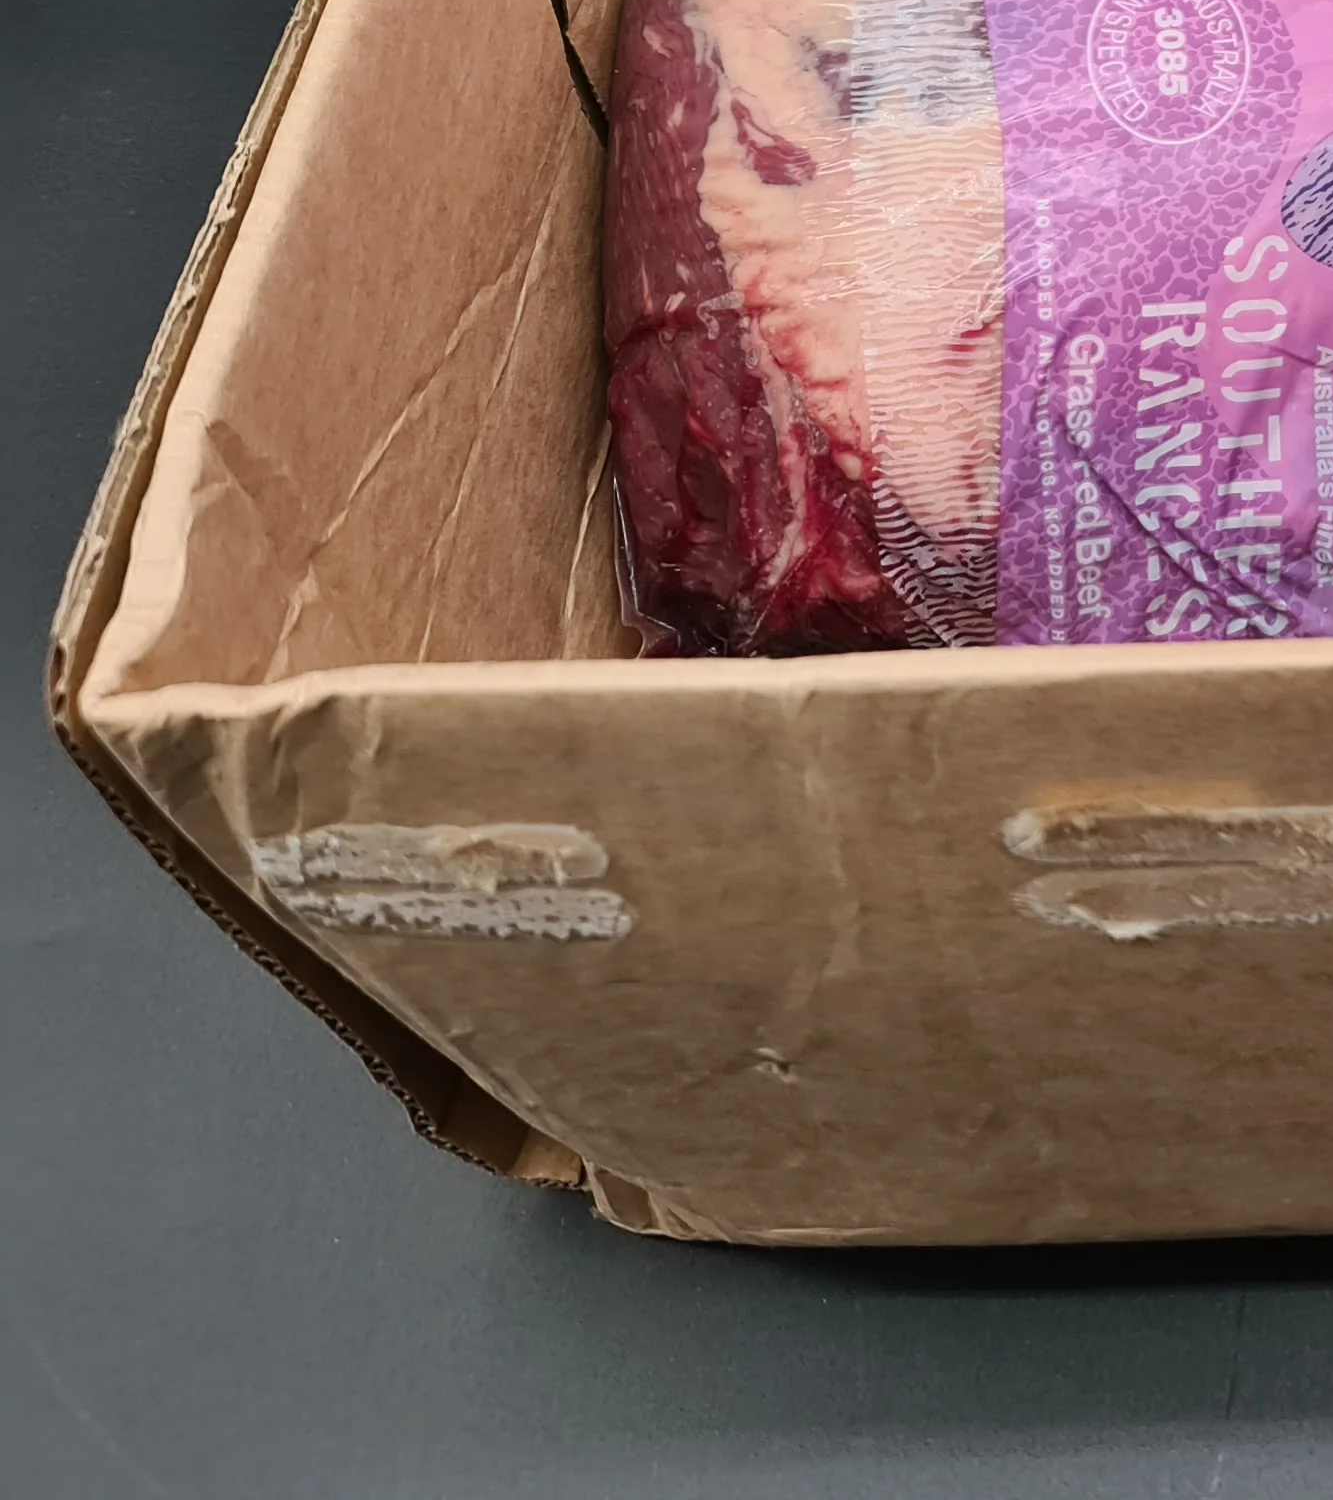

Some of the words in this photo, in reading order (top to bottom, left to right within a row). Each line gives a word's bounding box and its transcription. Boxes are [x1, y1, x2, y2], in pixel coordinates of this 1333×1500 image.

[1154, 6, 1190, 97] 3085
[1035, 200, 1050, 229] NO
[1036, 240, 1053, 322] ADDED
[1215, 234, 1290, 636] SOUTHER
[1044, 507, 1060, 536] NO
[1047, 546, 1065, 619] ADDED
[1075, 536, 1112, 618] Beef
